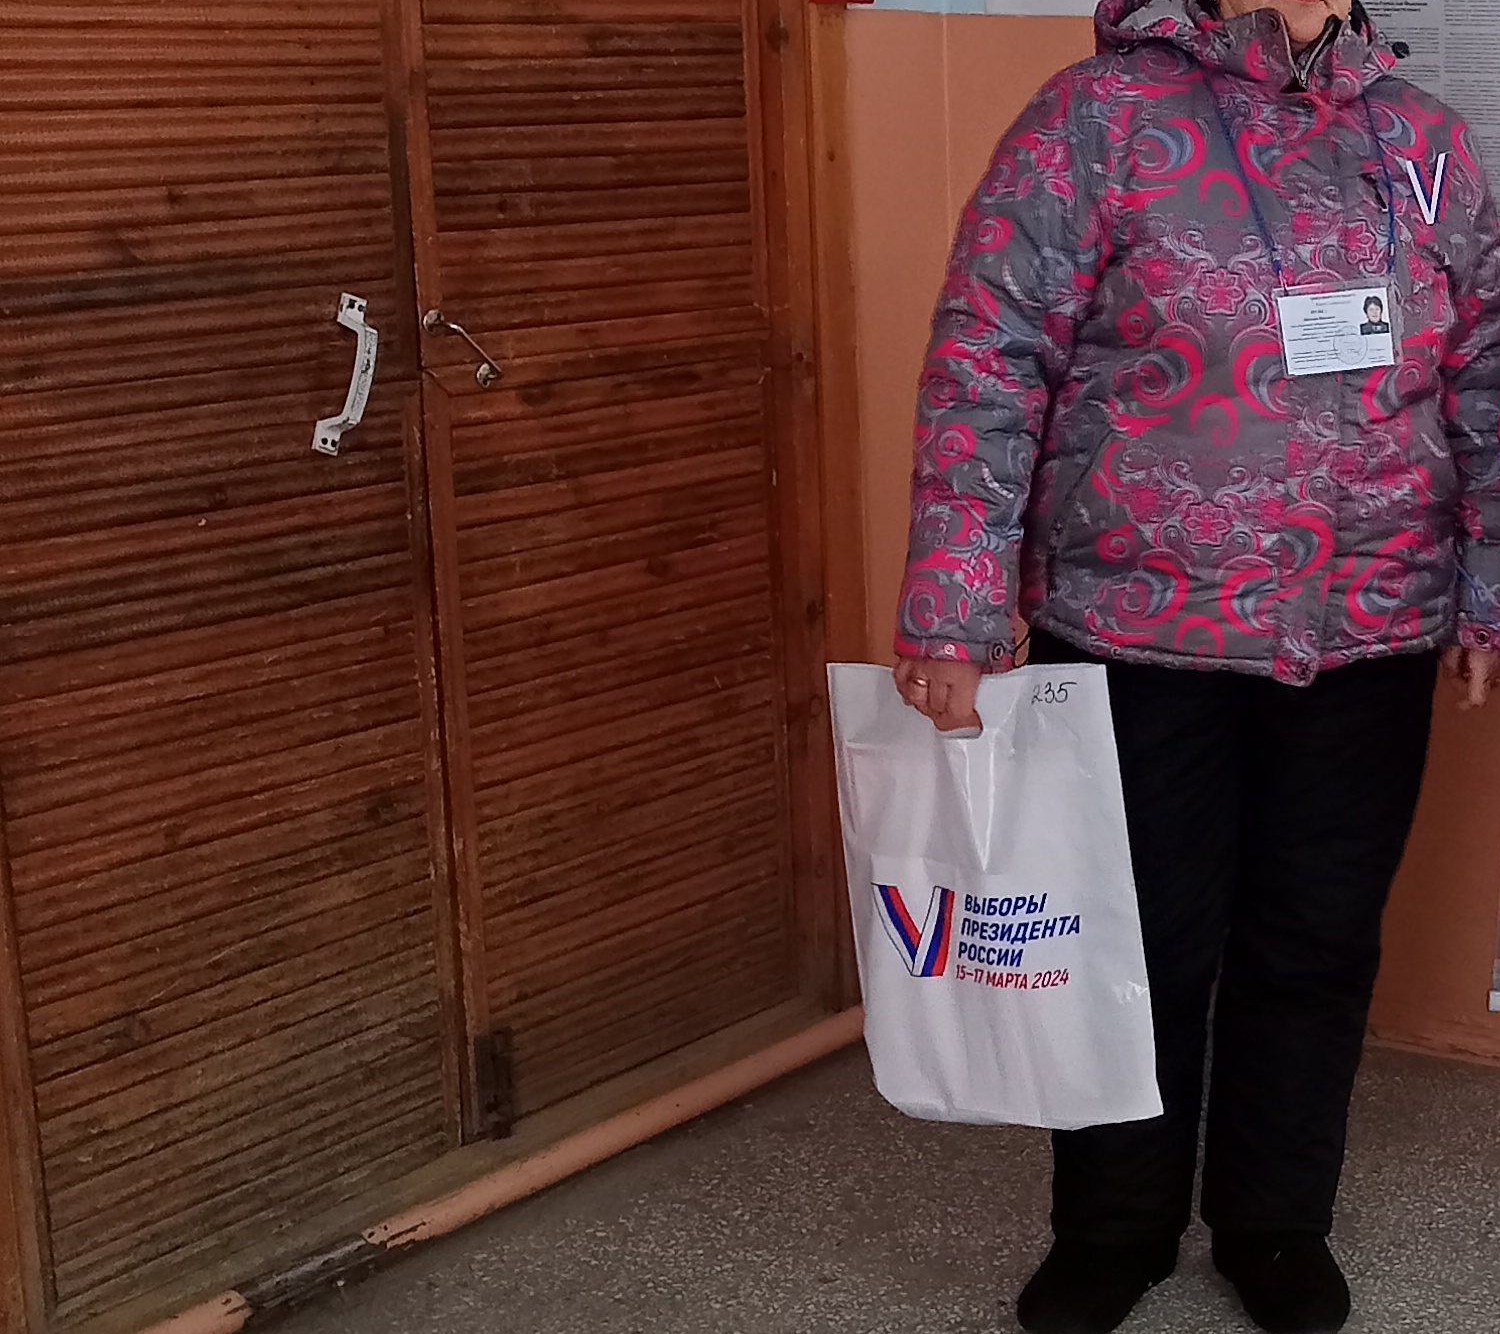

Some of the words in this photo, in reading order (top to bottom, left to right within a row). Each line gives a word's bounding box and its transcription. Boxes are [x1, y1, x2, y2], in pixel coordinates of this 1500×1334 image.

[1031, 681, 1078, 705] 235
[964, 892, 1048, 917] ВЫБОРЫ
[960, 914, 1081, 945] ПРЕЗИДЕНТА
[958, 941, 1024, 968] РОССИИ
[985, 972, 1028, 991] МАРТА
[1031, 968, 1070, 990] 2024
